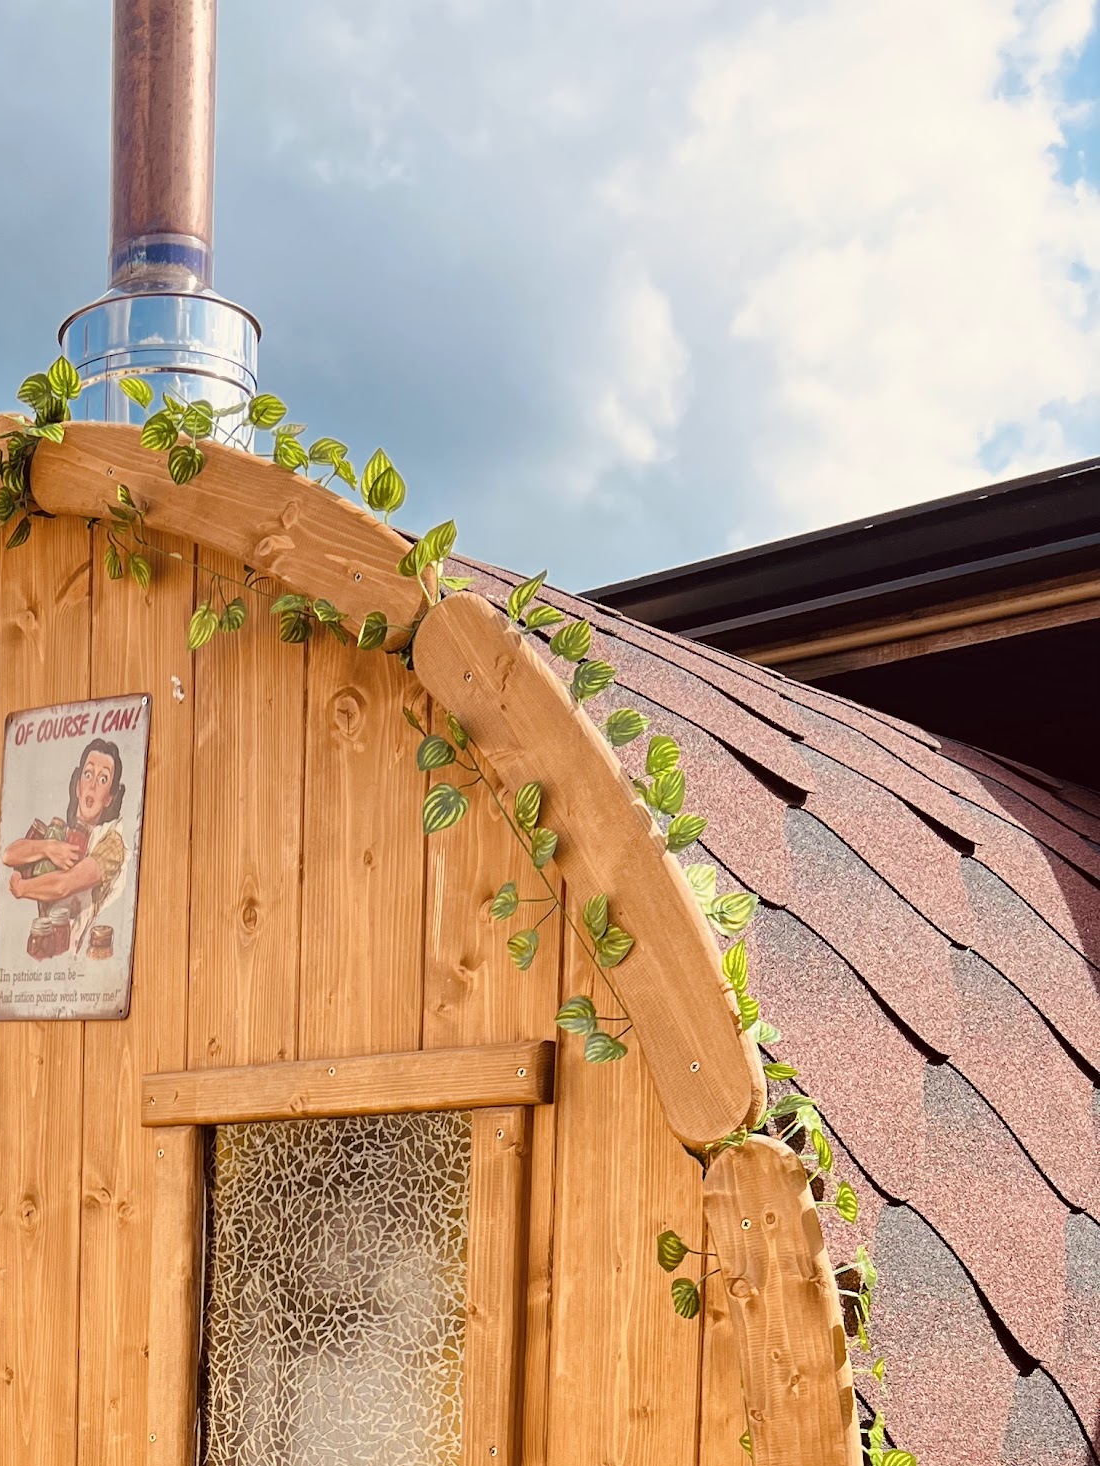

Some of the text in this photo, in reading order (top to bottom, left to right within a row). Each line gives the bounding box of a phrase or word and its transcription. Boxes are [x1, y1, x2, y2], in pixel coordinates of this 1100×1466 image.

[36, 713, 90, 743] COURSE
[91, 711, 100, 735] I
[101, 706, 142, 734] CAN!
[12, 970, 42, 986] patriotic
[43, 972, 52, 982] as
[53, 971, 66, 981] can
[14, 991, 35, 1003] ration
[35, 990, 58, 1006] points
[79, 991, 101, 1009] worry
